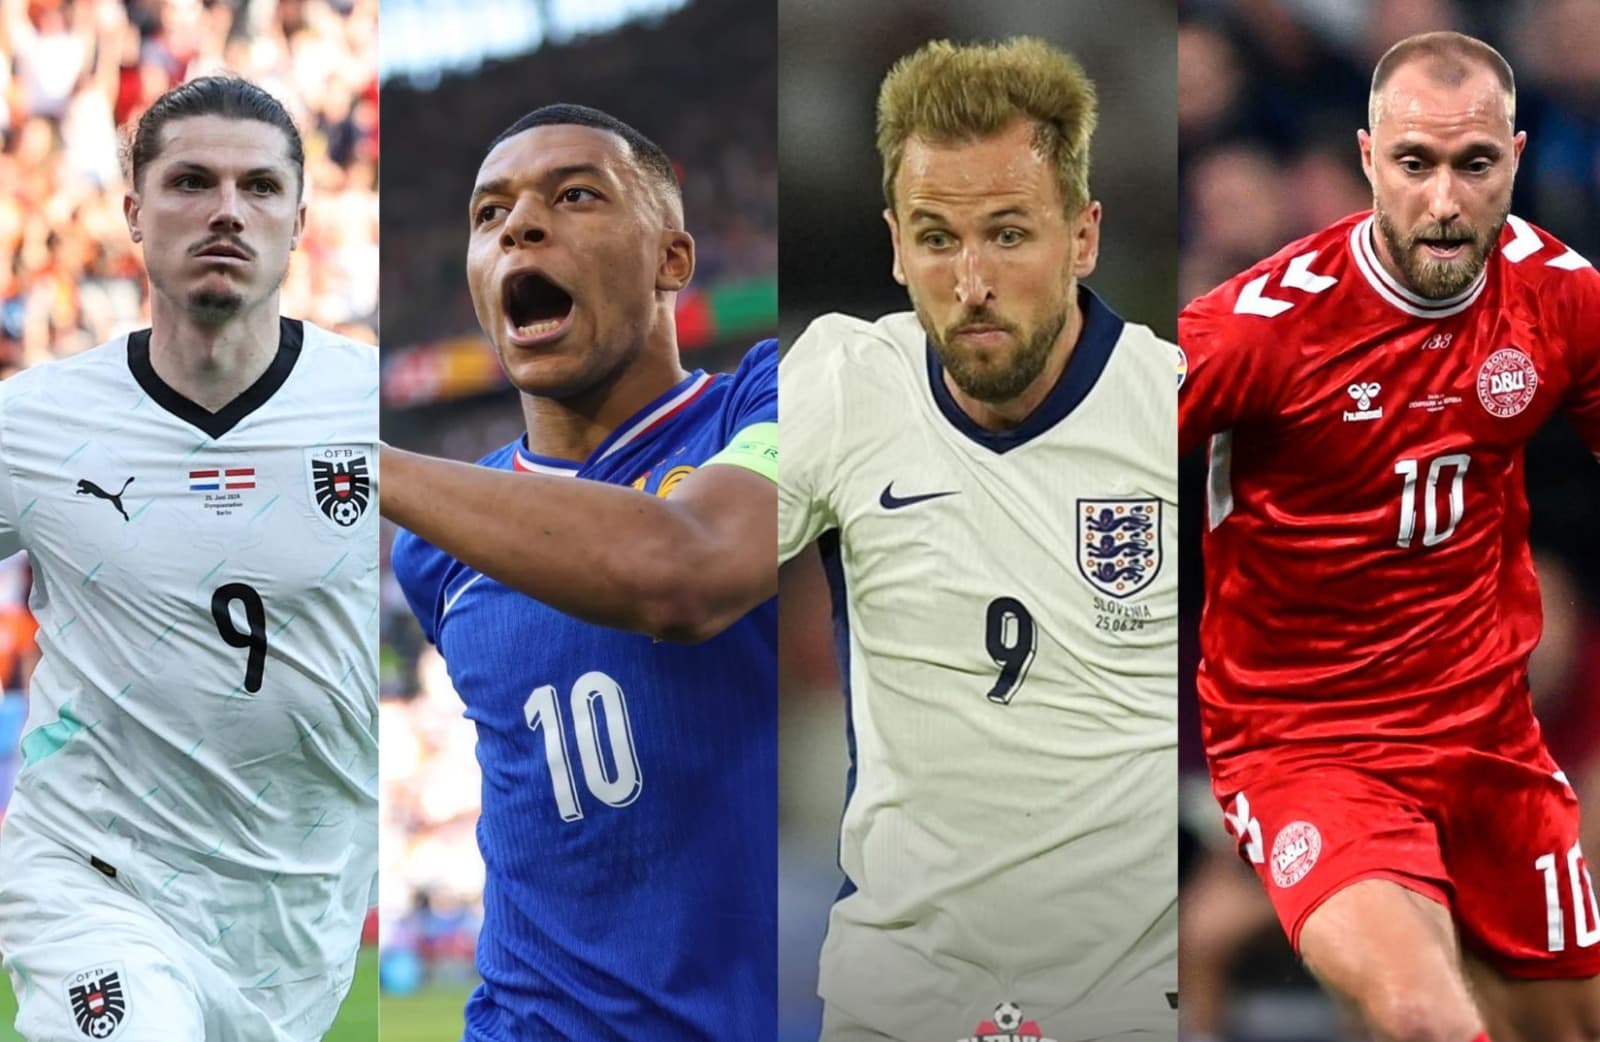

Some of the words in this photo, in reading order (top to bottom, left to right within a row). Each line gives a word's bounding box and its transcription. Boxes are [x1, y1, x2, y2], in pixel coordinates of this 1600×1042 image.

[1490, 370, 1526, 395] DBU
[1395, 453, 1472, 548] 10
[211, 582, 268, 693] 9
[985, 596, 1038, 705] 9
[1093, 596, 1153, 617] SLOVENIA
[523, 671, 643, 823] 10
[1277, 836, 1309, 872] DBU
[1535, 840, 1600, 952] 10
